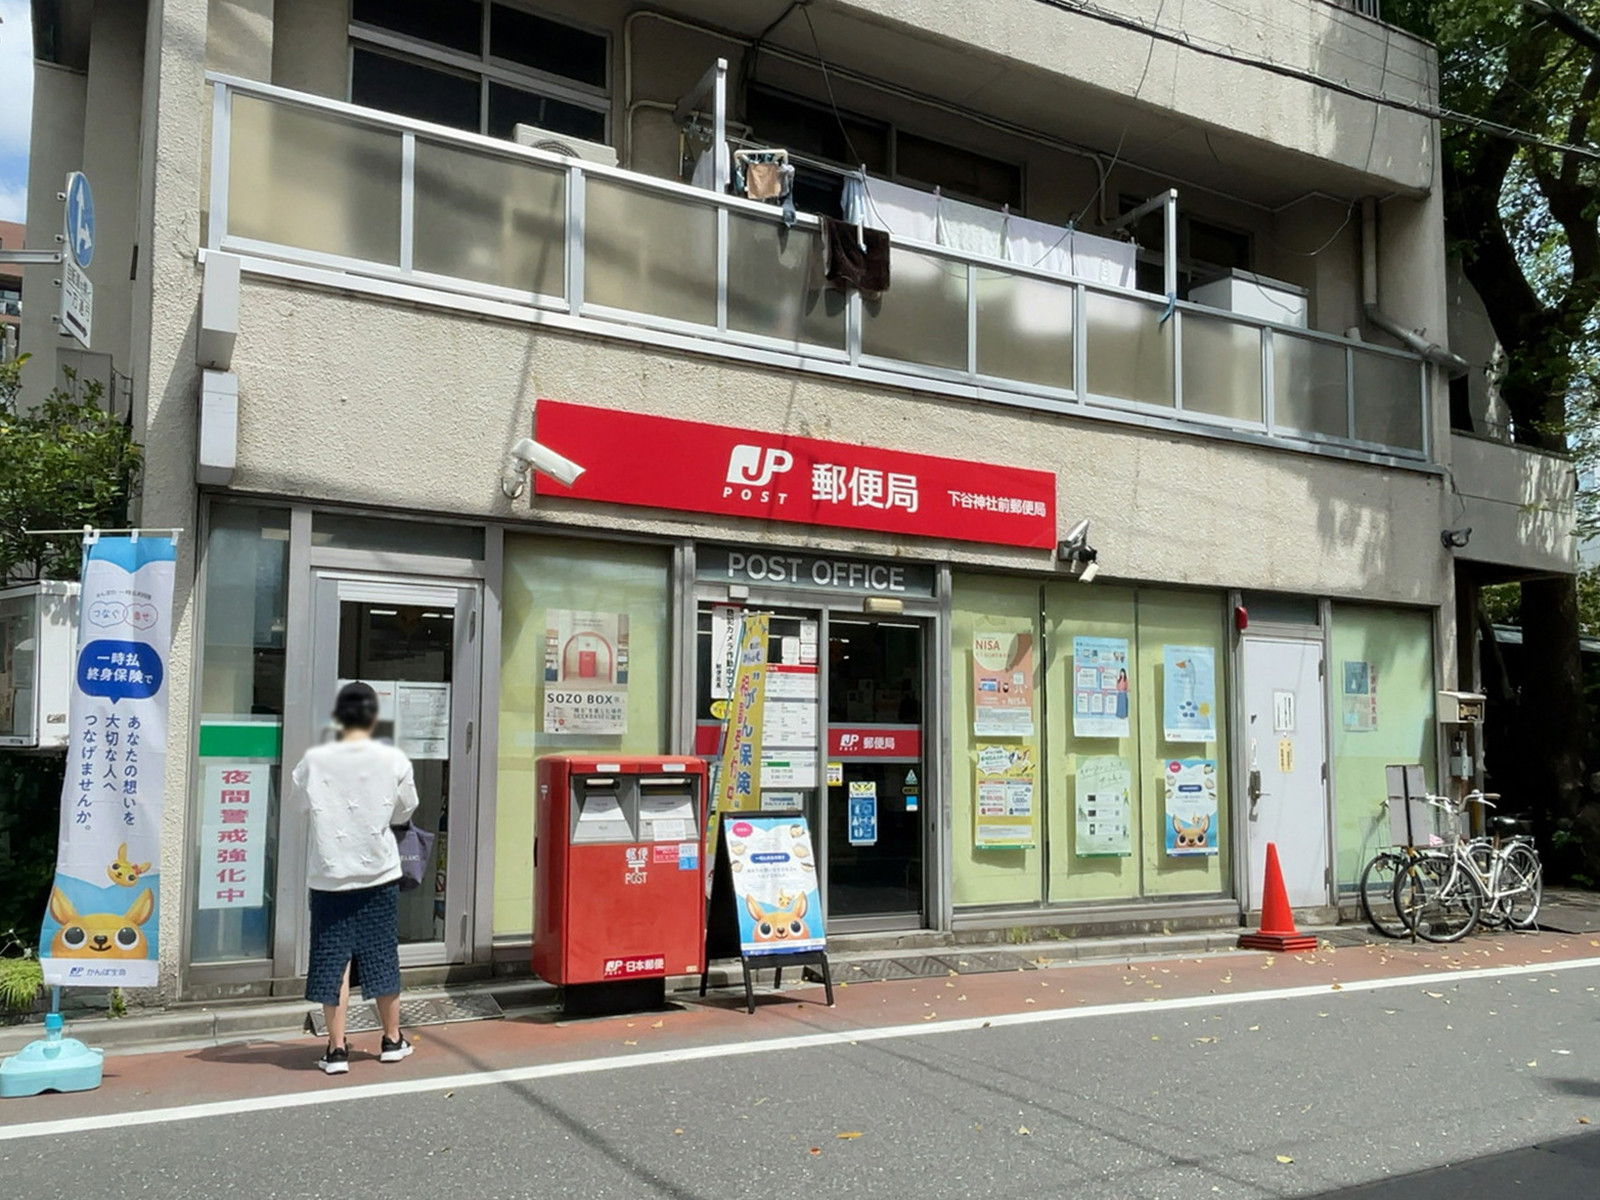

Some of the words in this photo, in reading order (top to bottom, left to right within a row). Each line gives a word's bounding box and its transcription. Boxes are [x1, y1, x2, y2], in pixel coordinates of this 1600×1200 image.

[722, 487, 788, 505] POST
[811, 463, 919, 513] 郵便局
[947, 490, 1047, 518] 下谷神社前郵便局
[728, 553, 802, 583] POST
[811, 560, 906, 592] OFFICE
[976, 640, 1001, 651] NISA
[96, 652, 141, 667] 一時払
[86, 667, 153, 685] 終身保険で
[547, 692, 582, 704] SOZO
[587, 694, 612, 704] BOX
[103, 713, 121, 792] 大切な人へ
[863, 737, 895, 750] 郵便局
[76, 714, 98, 831] つなげませんか。
[122, 715, 141, 826] あなたの想いを
[215, 769, 252, 902] 夜間警戒強化中
[625, 847, 648, 861] 郵便
[625, 871, 648, 885] POST
[626, 958, 664, 972] 日本郵便
